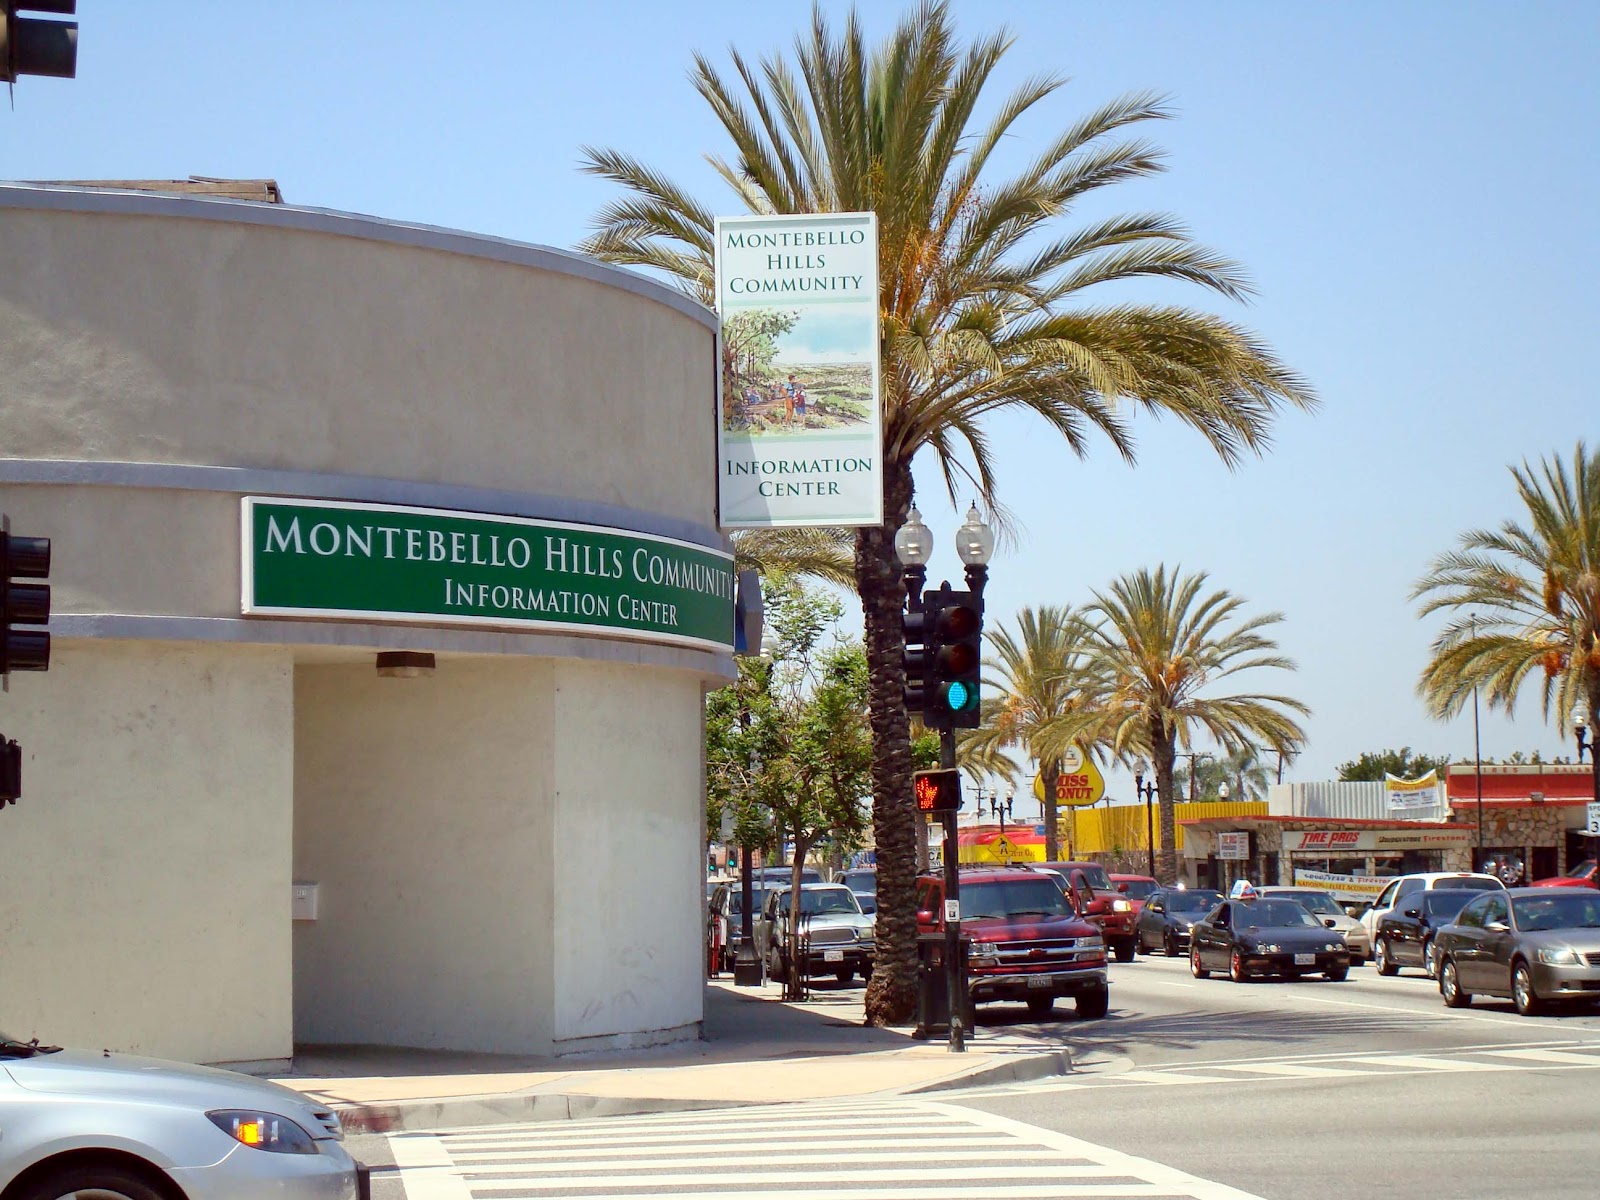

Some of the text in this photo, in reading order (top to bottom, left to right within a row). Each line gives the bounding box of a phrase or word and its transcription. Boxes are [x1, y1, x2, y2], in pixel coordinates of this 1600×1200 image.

[727, 229, 865, 249] MONTEBELLO
[767, 254, 826, 270] HILLS
[729, 275, 863, 294] COMMUNITY
[727, 457, 873, 476] INFORMATION
[758, 481, 841, 498] CENTER
[262, 514, 733, 601] MONTEBELLO HILLS COMMUNITY
[444, 578, 679, 627] INFORMATION CENTER
[1057, 787, 1094, 799] ONUT
[1298, 832, 1360, 849] TIRE PROS
